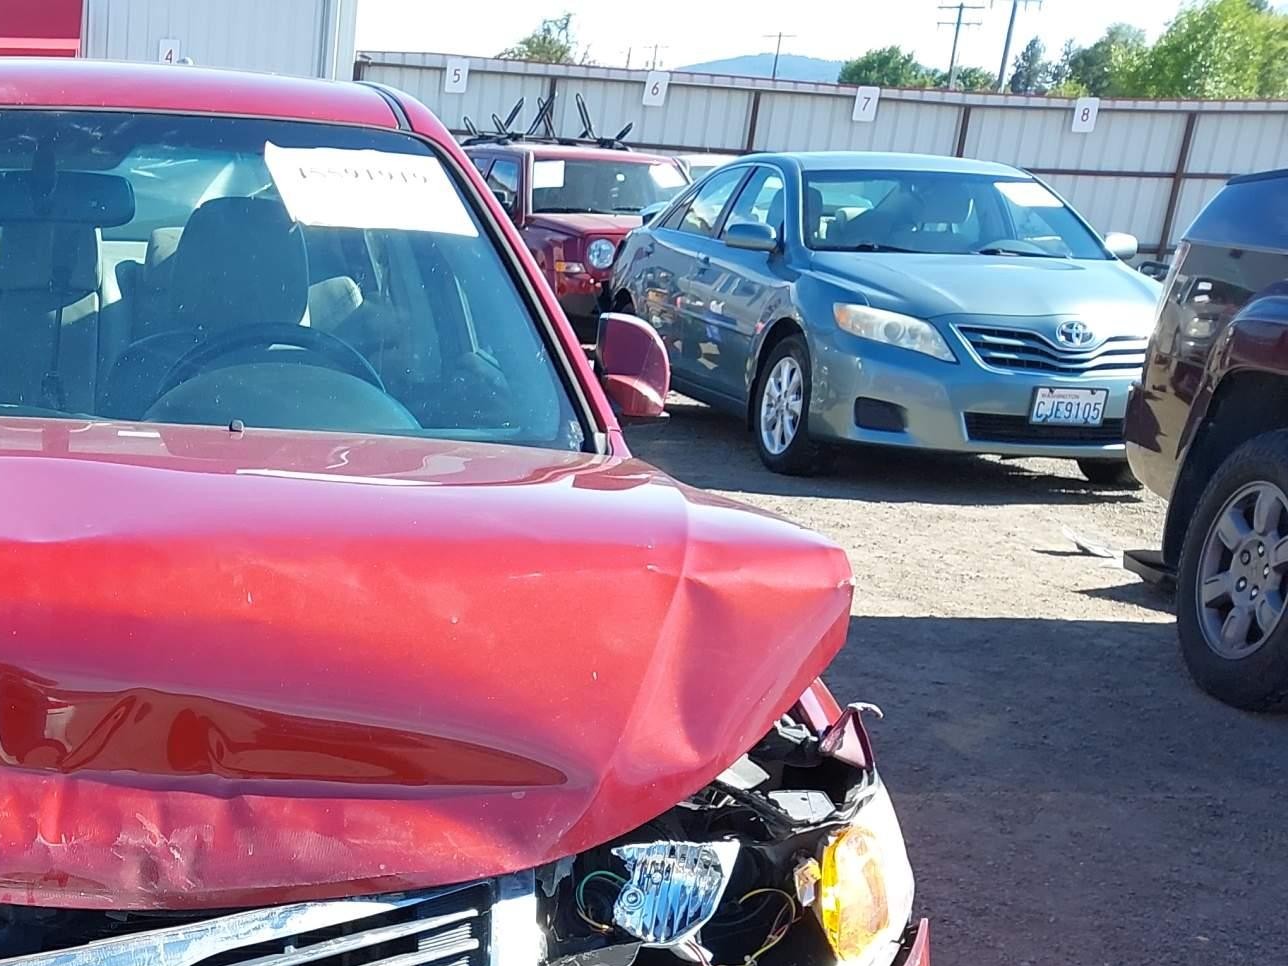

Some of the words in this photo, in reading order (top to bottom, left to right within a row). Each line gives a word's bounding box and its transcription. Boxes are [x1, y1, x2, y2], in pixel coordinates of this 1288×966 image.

[165, 48, 173, 64] 4
[453, 69, 461, 83] 5
[652, 81, 660, 96] 6
[862, 96, 871, 111] 7
[1080, 108, 1090, 122] 8
[1035, 401, 1102, 420] CJE9105
